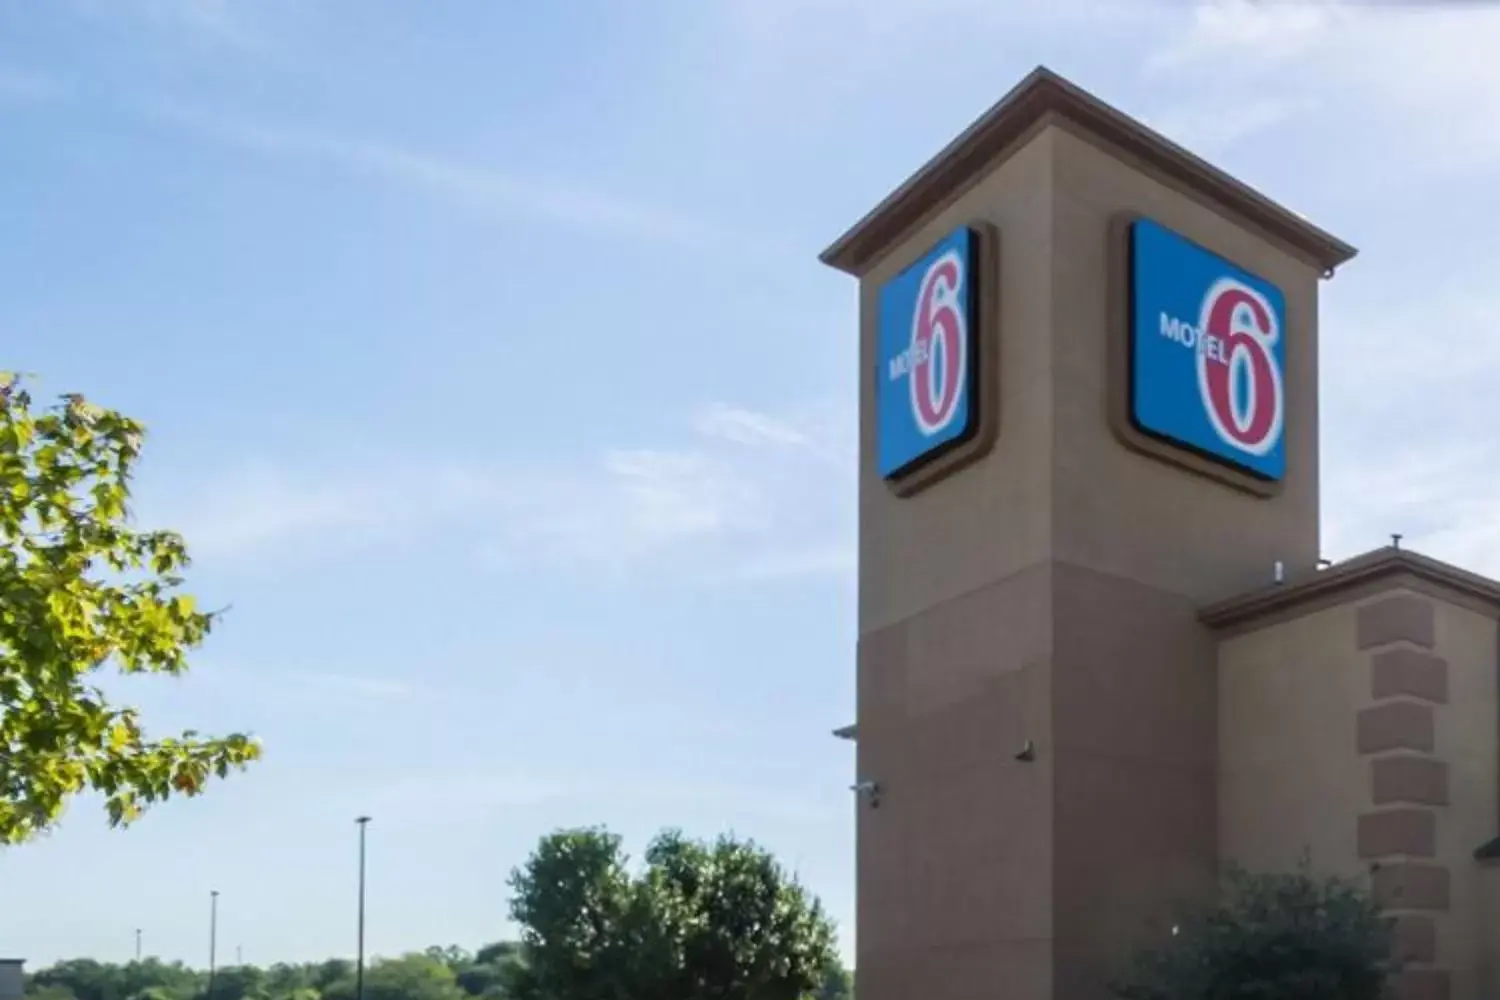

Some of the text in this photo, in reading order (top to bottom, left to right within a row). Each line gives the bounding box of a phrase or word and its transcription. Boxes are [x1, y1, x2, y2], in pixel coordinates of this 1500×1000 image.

[909, 248, 967, 436] 6
[1159, 276, 1283, 456] MOTEL 6
